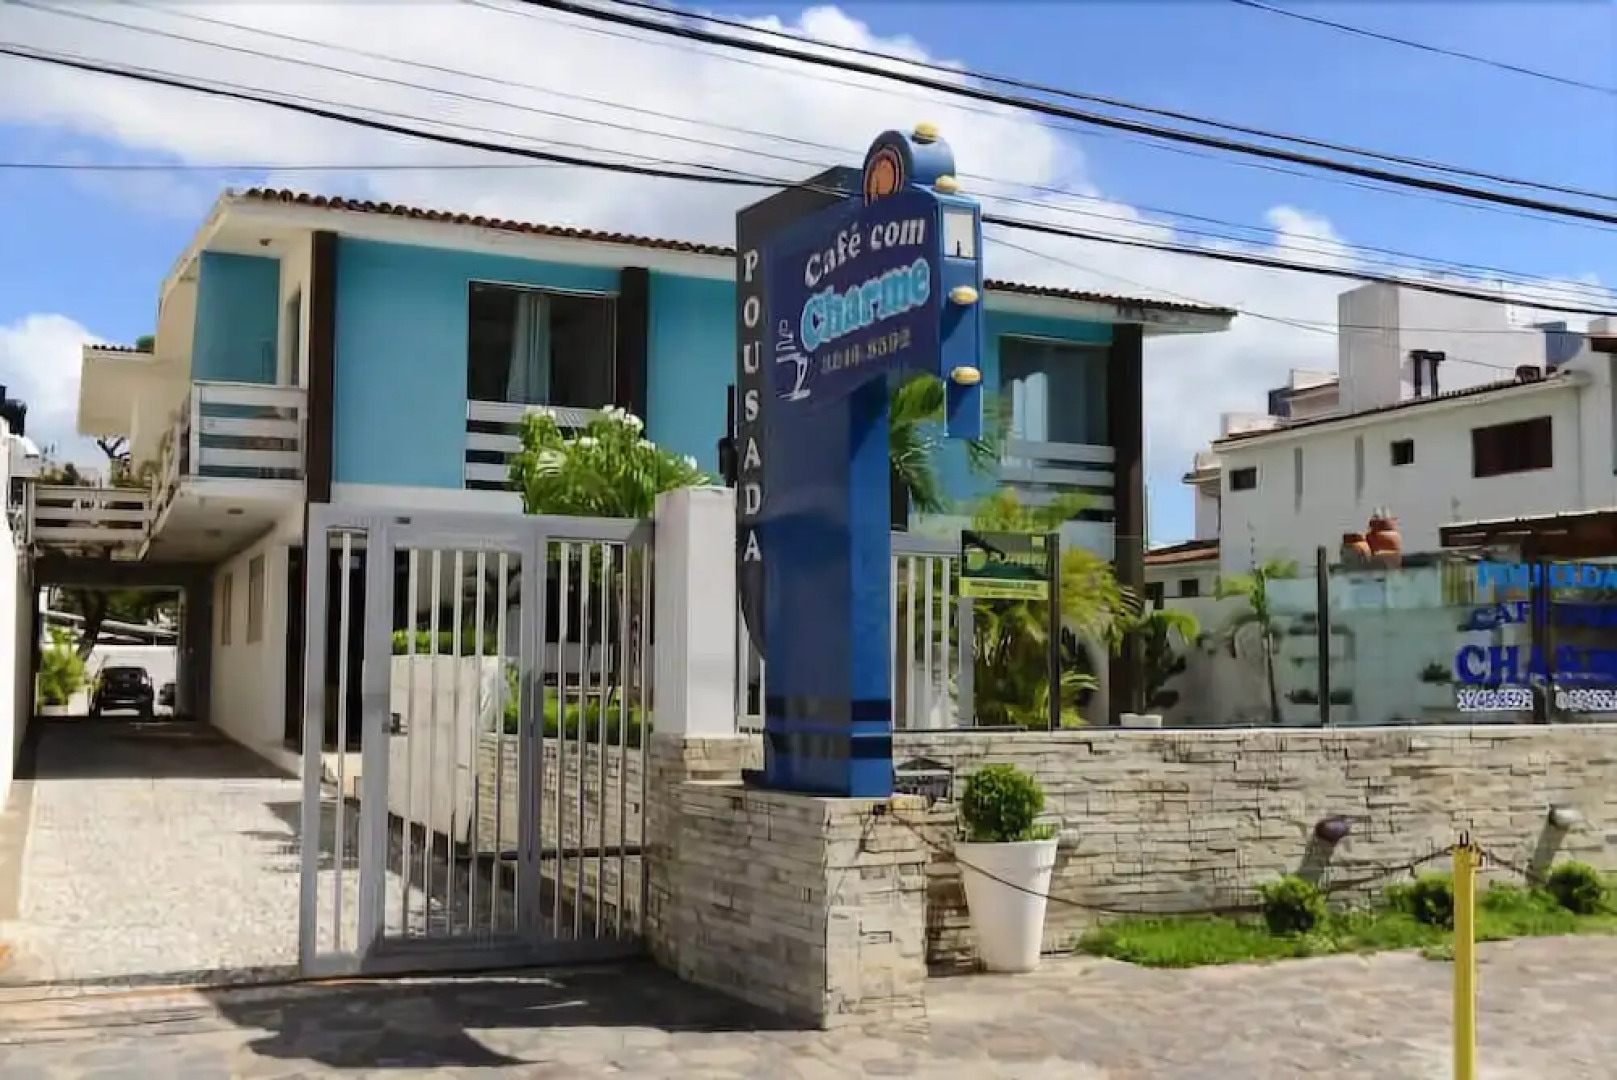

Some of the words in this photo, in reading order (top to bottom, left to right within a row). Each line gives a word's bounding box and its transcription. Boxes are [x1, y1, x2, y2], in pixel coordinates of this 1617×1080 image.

[804, 222, 861, 287] Café
[869, 218, 926, 250] com
[800, 256, 931, 352] Charme
[742, 248, 762, 563] POUSADA
